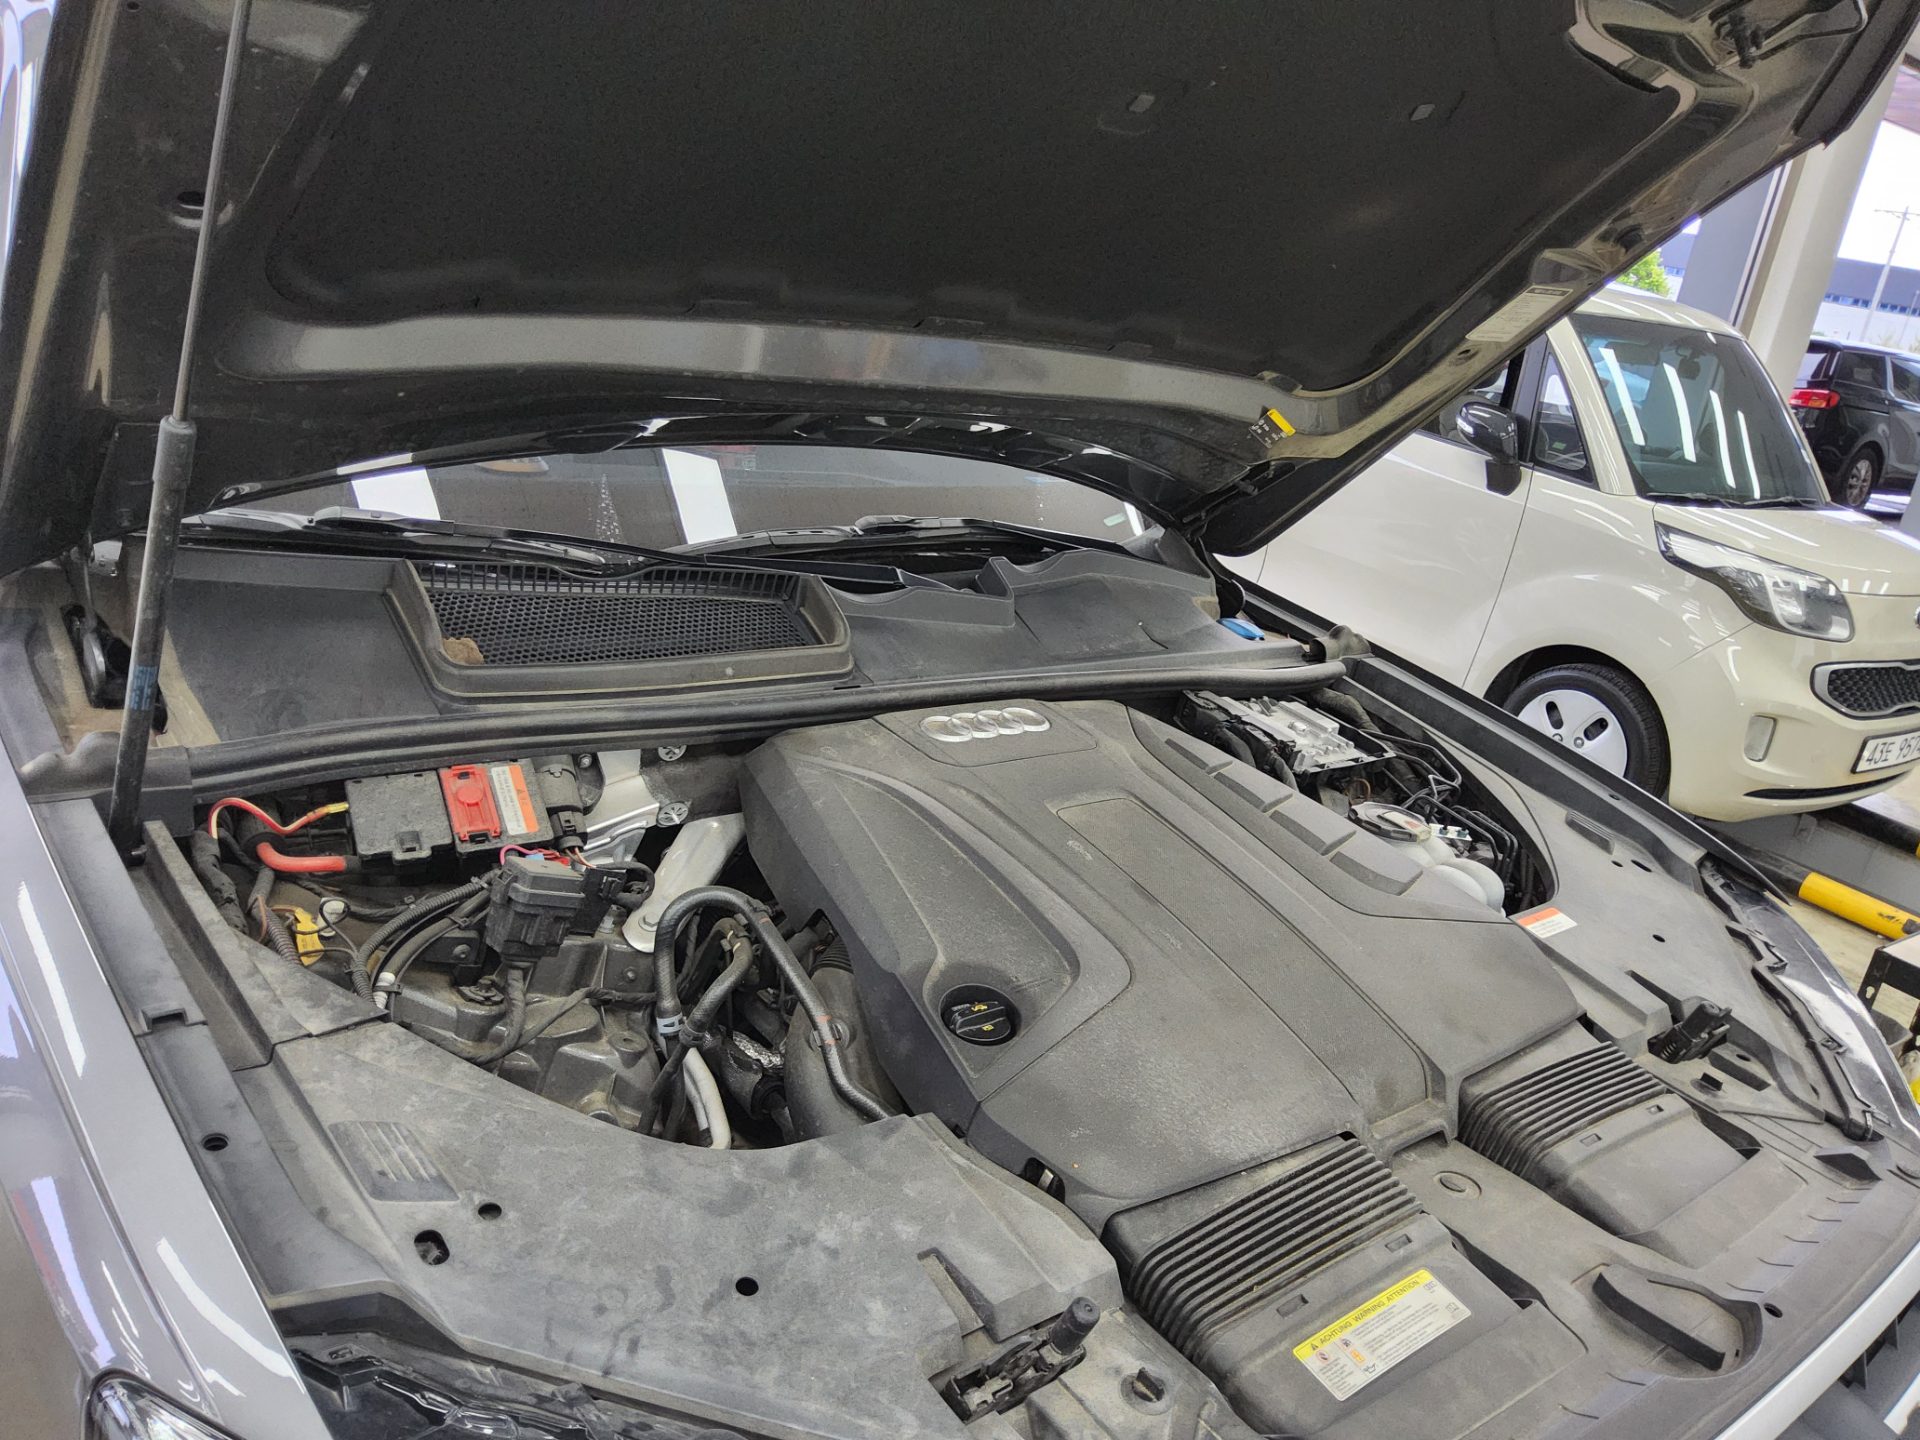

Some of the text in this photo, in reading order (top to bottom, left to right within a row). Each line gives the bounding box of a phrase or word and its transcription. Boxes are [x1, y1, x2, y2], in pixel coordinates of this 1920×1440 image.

[1319, 1279, 1420, 1345] ACHTUNG WARNING ATTENTION
